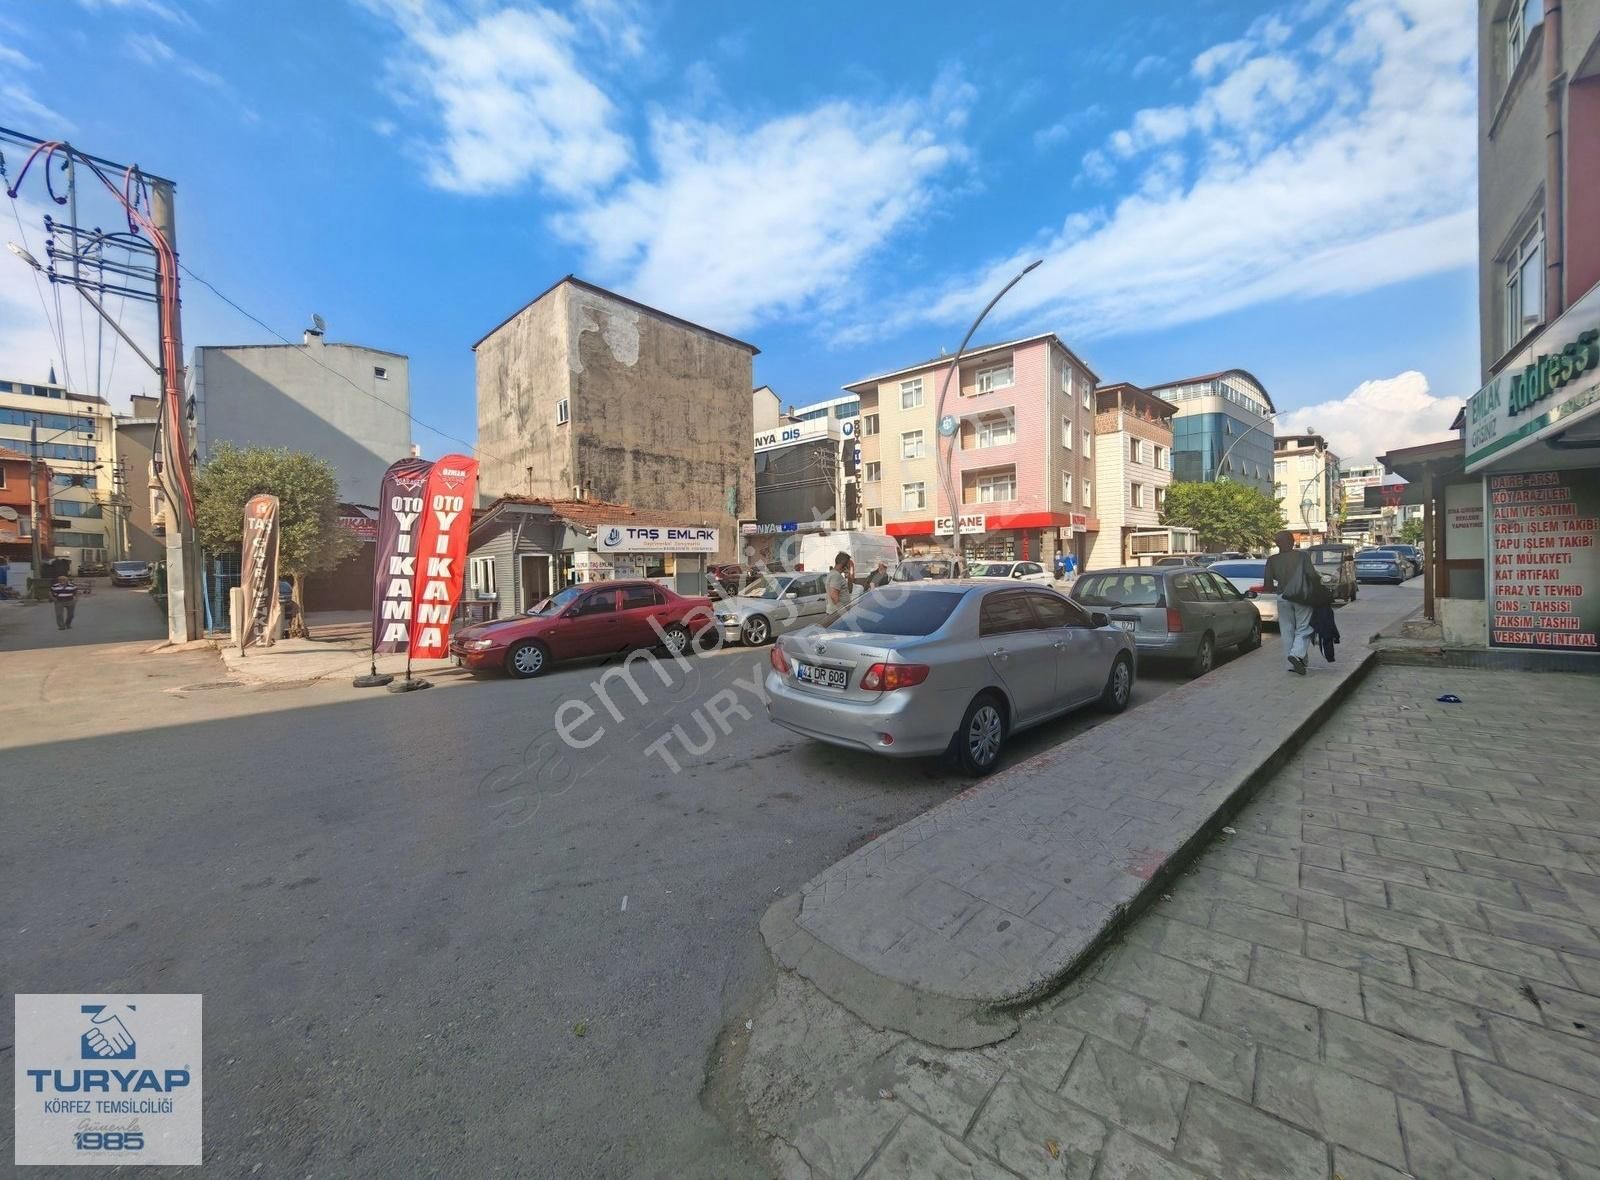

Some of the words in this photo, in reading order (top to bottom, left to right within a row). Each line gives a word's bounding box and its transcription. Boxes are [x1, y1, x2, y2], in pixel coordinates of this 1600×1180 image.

[1508, 328, 1599, 417] Address
[1473, 377, 1501, 425] EMLAK
[782, 428, 800, 441] DİŞ
[391, 496, 424, 512] OTO
[433, 494, 464, 512] OTO
[1494, 507, 1519, 519] ALIM
[1522, 506, 1535, 517] VE
[1540, 504, 1577, 516] SATIMI
[937, 516, 983, 529] ECANE
[626, 528, 660, 541] TAŞ
[667, 530, 714, 540] EMLAK
[1495, 538, 1520, 550] TAPU
[1495, 554, 1513, 565] KAT
[382, 512, 419, 642] YIKAMA
[417, 511, 459, 648] YIKAMA
[1495, 569, 1513, 580] KAT
[1527, 585, 1541, 596] VE
[1536, 632, 1551, 644] VE
[814, 668, 827, 680] DR
[828, 670, 845, 684] 608
